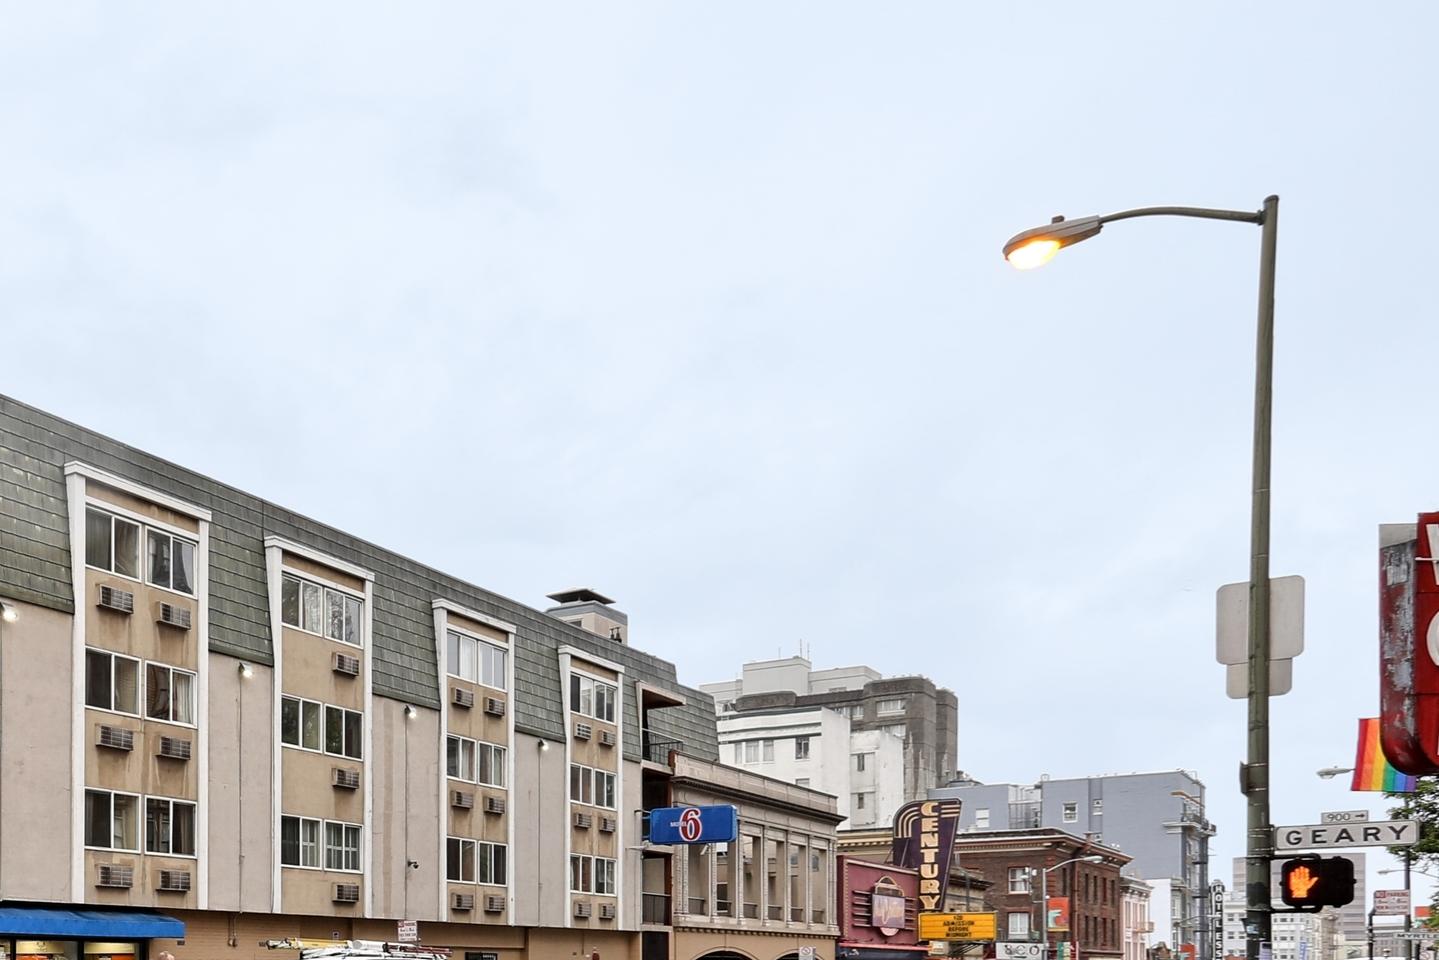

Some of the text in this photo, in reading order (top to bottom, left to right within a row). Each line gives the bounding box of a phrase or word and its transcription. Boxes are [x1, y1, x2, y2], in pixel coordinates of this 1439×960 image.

[679, 808, 702, 842] 6
[1327, 813, 1350, 822] 900
[1286, 825, 1408, 845] GEARY
[919, 802, 940, 909] CENTURY
[1215, 885, 1223, 928] HOTEL
